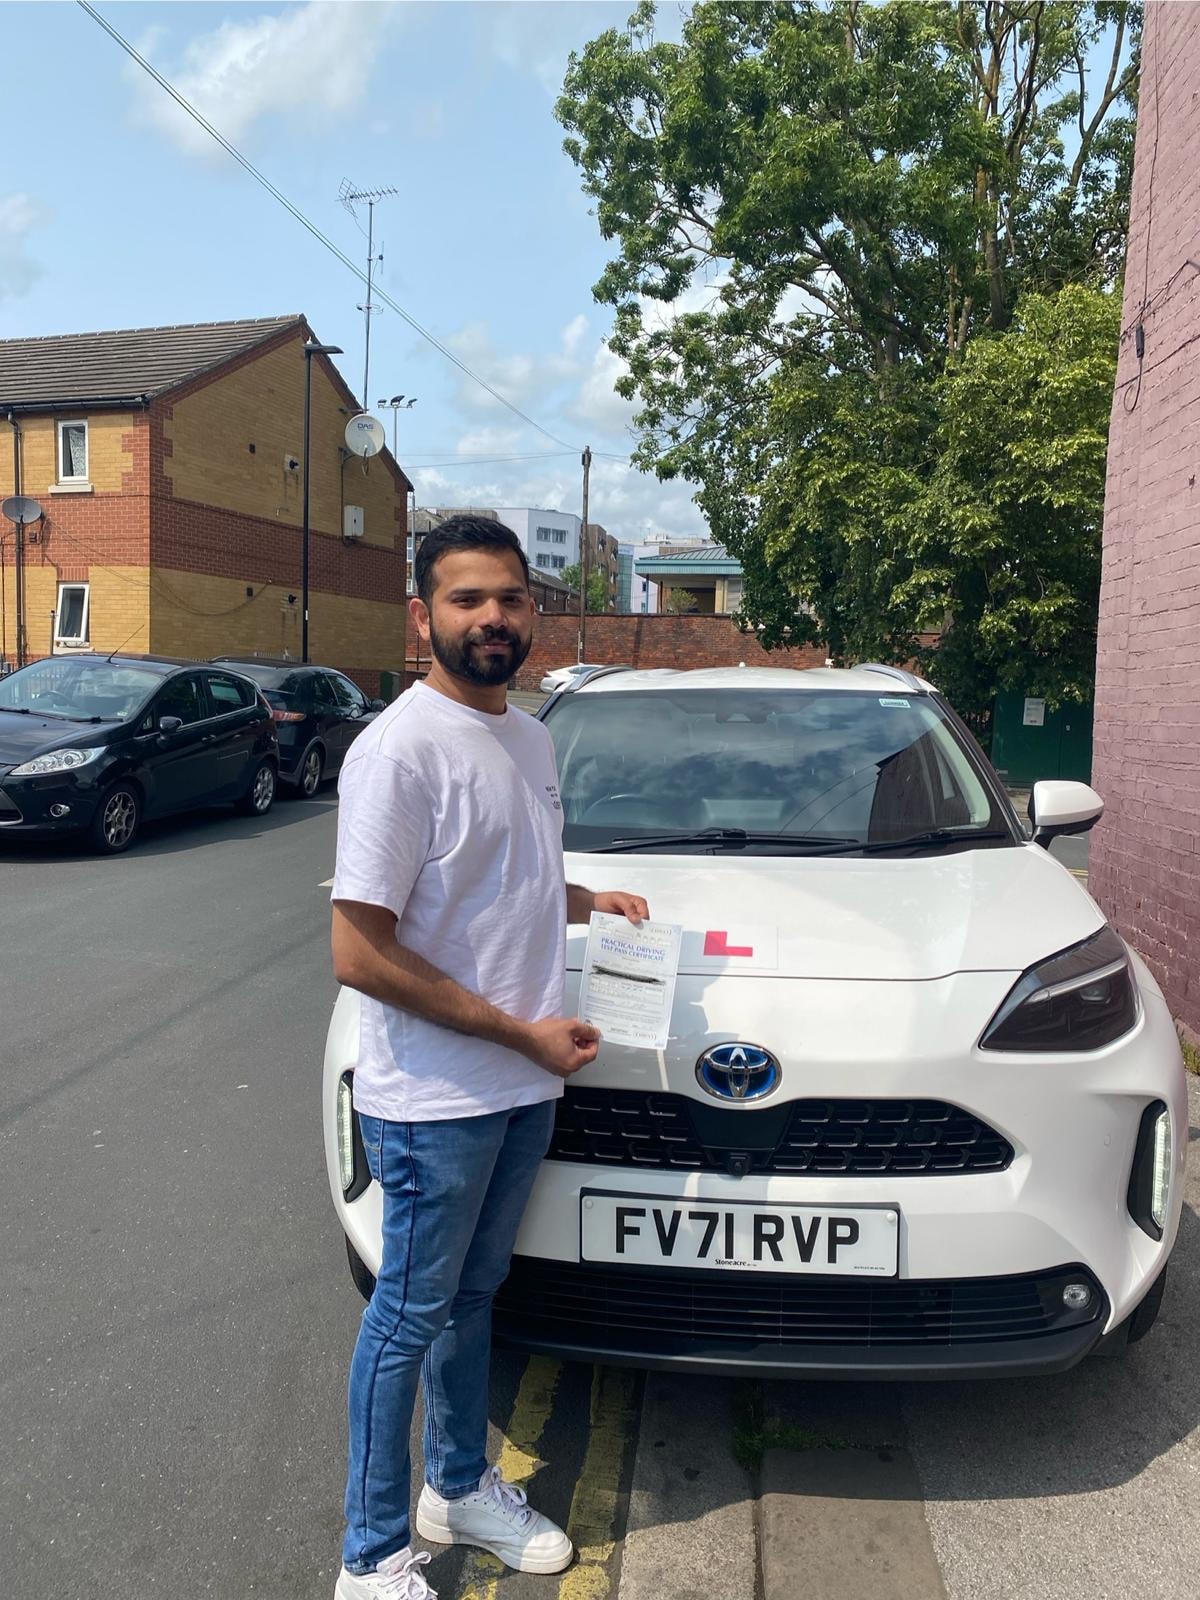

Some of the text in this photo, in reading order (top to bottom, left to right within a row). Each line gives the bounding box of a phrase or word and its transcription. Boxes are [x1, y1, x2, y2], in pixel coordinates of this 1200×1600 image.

[601, 937, 665, 956] PRACTICAL DRIVING
[601, 943, 613, 952] TEST
[614, 947, 628, 955] PASS
[628, 949, 664, 961] CERTIFICATE
[616, 1206, 860, 1264] FV71 RVP
